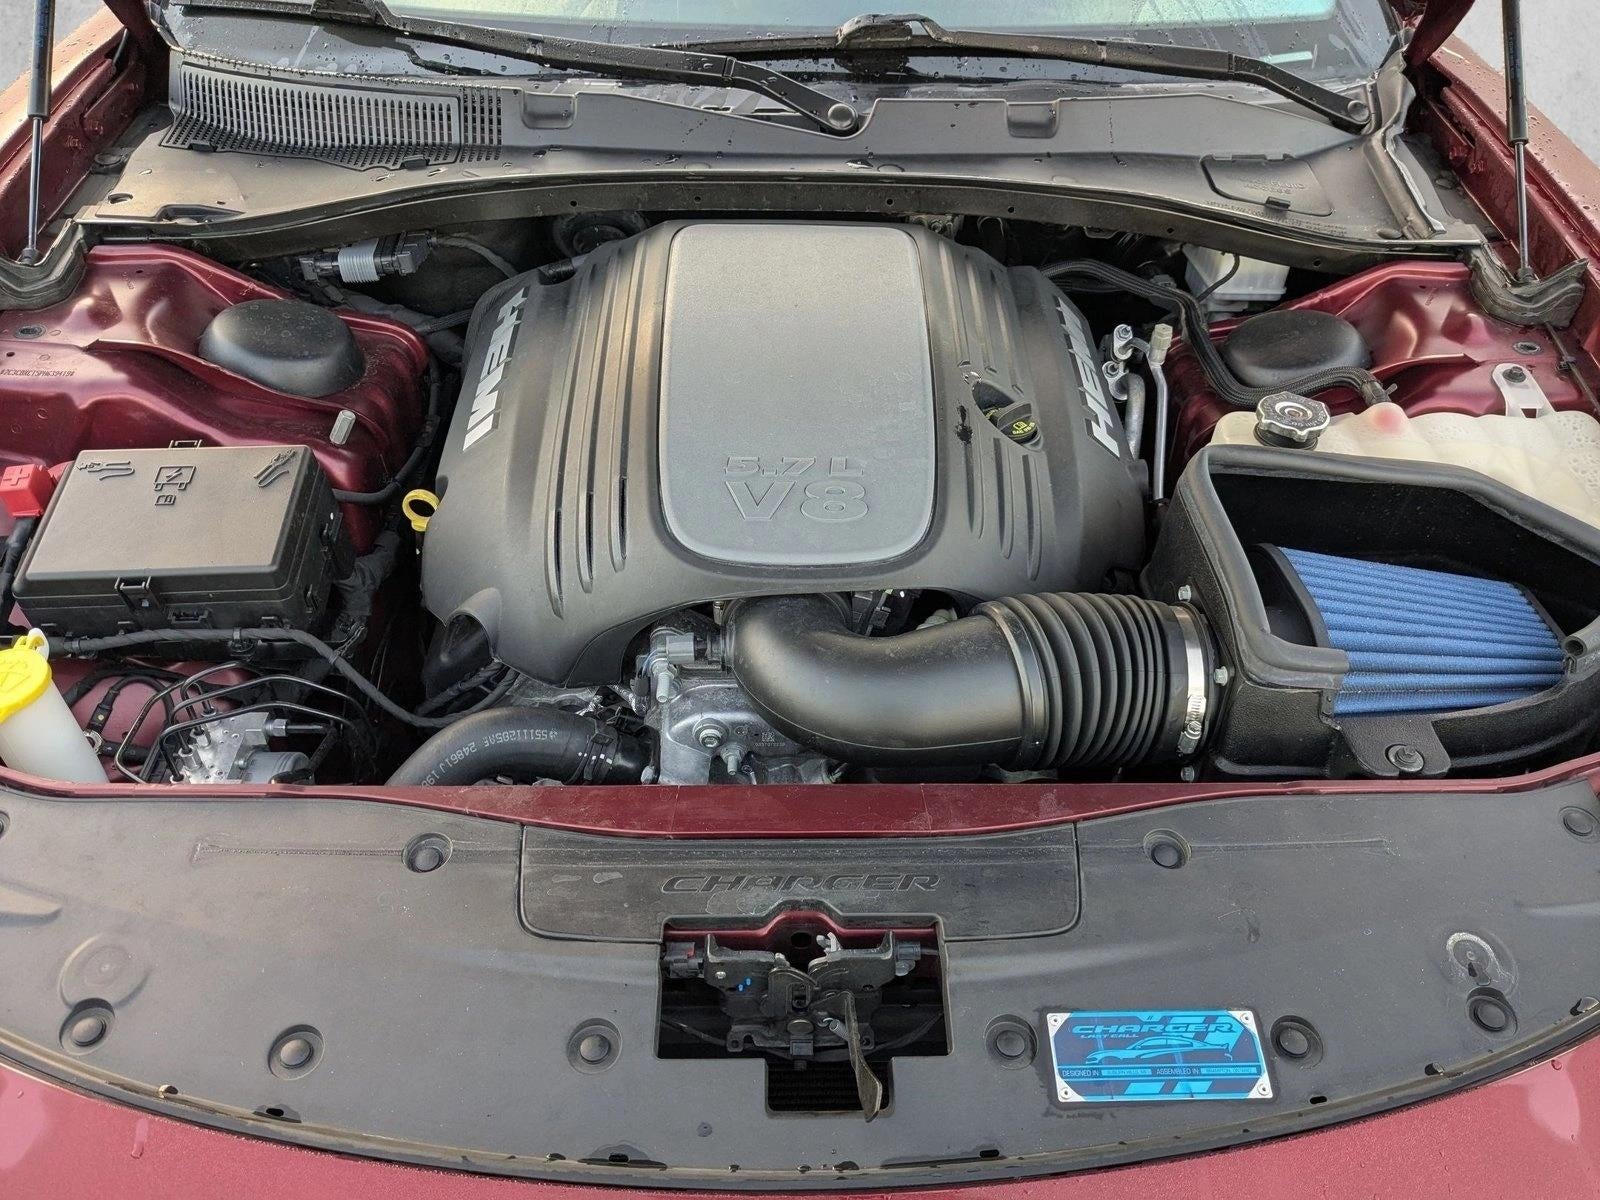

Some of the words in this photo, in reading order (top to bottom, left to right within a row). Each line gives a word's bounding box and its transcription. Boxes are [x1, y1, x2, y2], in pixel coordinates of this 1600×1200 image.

[462, 287, 527, 451] HEMI
[1055, 296, 1121, 458] HEMI
[724, 480, 870, 523] V8
[660, 873, 941, 894] CHARGER
[1072, 1022, 1236, 1034] CHARGER
[1062, 1069, 1091, 1077] DESIGNED
[1156, 1067, 1192, 1075] ASSEMBLED
